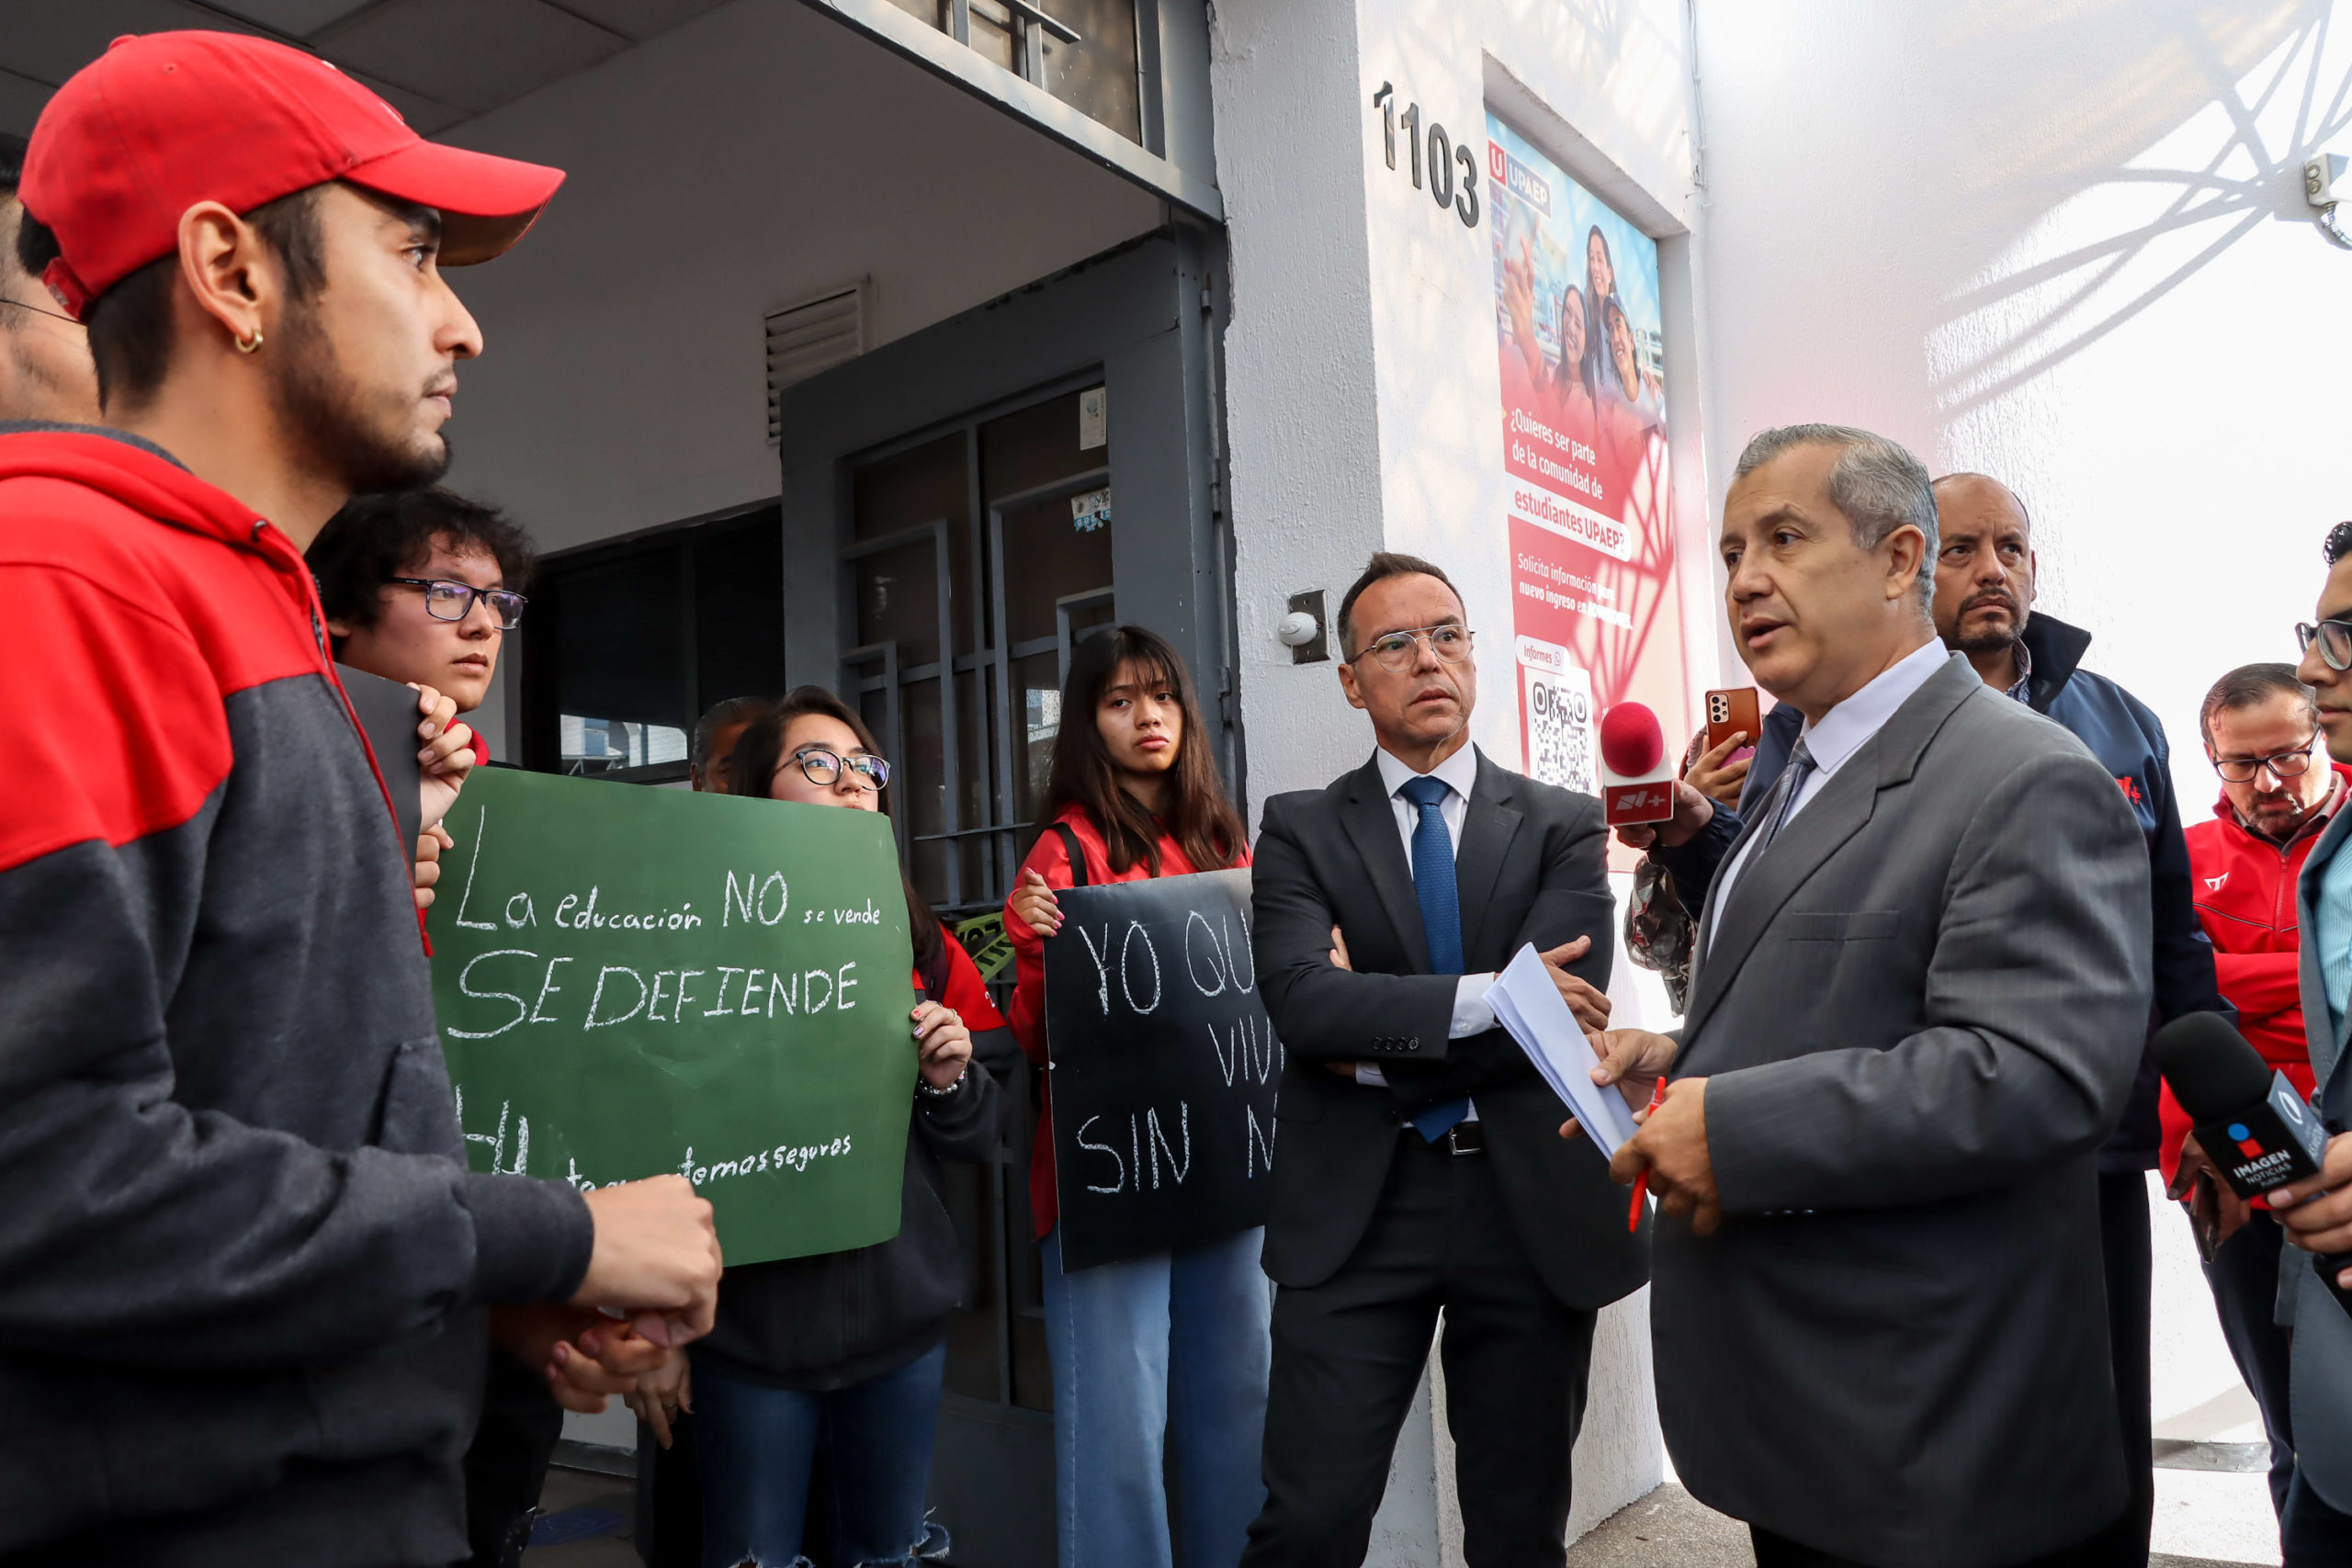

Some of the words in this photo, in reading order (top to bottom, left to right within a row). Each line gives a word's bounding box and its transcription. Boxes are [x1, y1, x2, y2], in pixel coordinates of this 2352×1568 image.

[1374, 80, 1480, 229] 1103
[1509, 162, 1548, 208] UPAEP
[1510, 407, 1554, 446] ¿Quieres
[1555, 431, 1570, 453] ser
[1571, 439, 1596, 467] parte
[1511, 438, 1526, 465] de
[1527, 444, 1538, 470] la
[1539, 456, 1590, 495] comunidad
[1591, 476, 1603, 500] de
[1514, 490, 1583, 535] estudiantes
[1584, 516, 1625, 554] UPAEP?
[1518, 552, 1550, 579] Solicita
[1551, 563, 1597, 596] información
[1519, 580, 1545, 602] nuevo
[1546, 583, 1576, 610] ingreso
[1577, 599, 1588, 615] en
[1523, 643, 1553, 666] Informes
[456, 804, 537, 931] La
[554, 884, 702, 931] educación
[721, 869, 789, 928] NO
[803, 908, 825, 925] se
[834, 897, 882, 926] vende
[1078, 919, 1162, 1016] YO
[1184, 907, 1256, 998] QU
[447, 948, 575, 1040] SE
[582, 961, 858, 1032] DEFIENDE
[1077, 1100, 1191, 1194] SIN
[2233, 1149, 2290, 1179] IMAGEN
[2245, 1161, 2293, 1185] NOTICIAS
